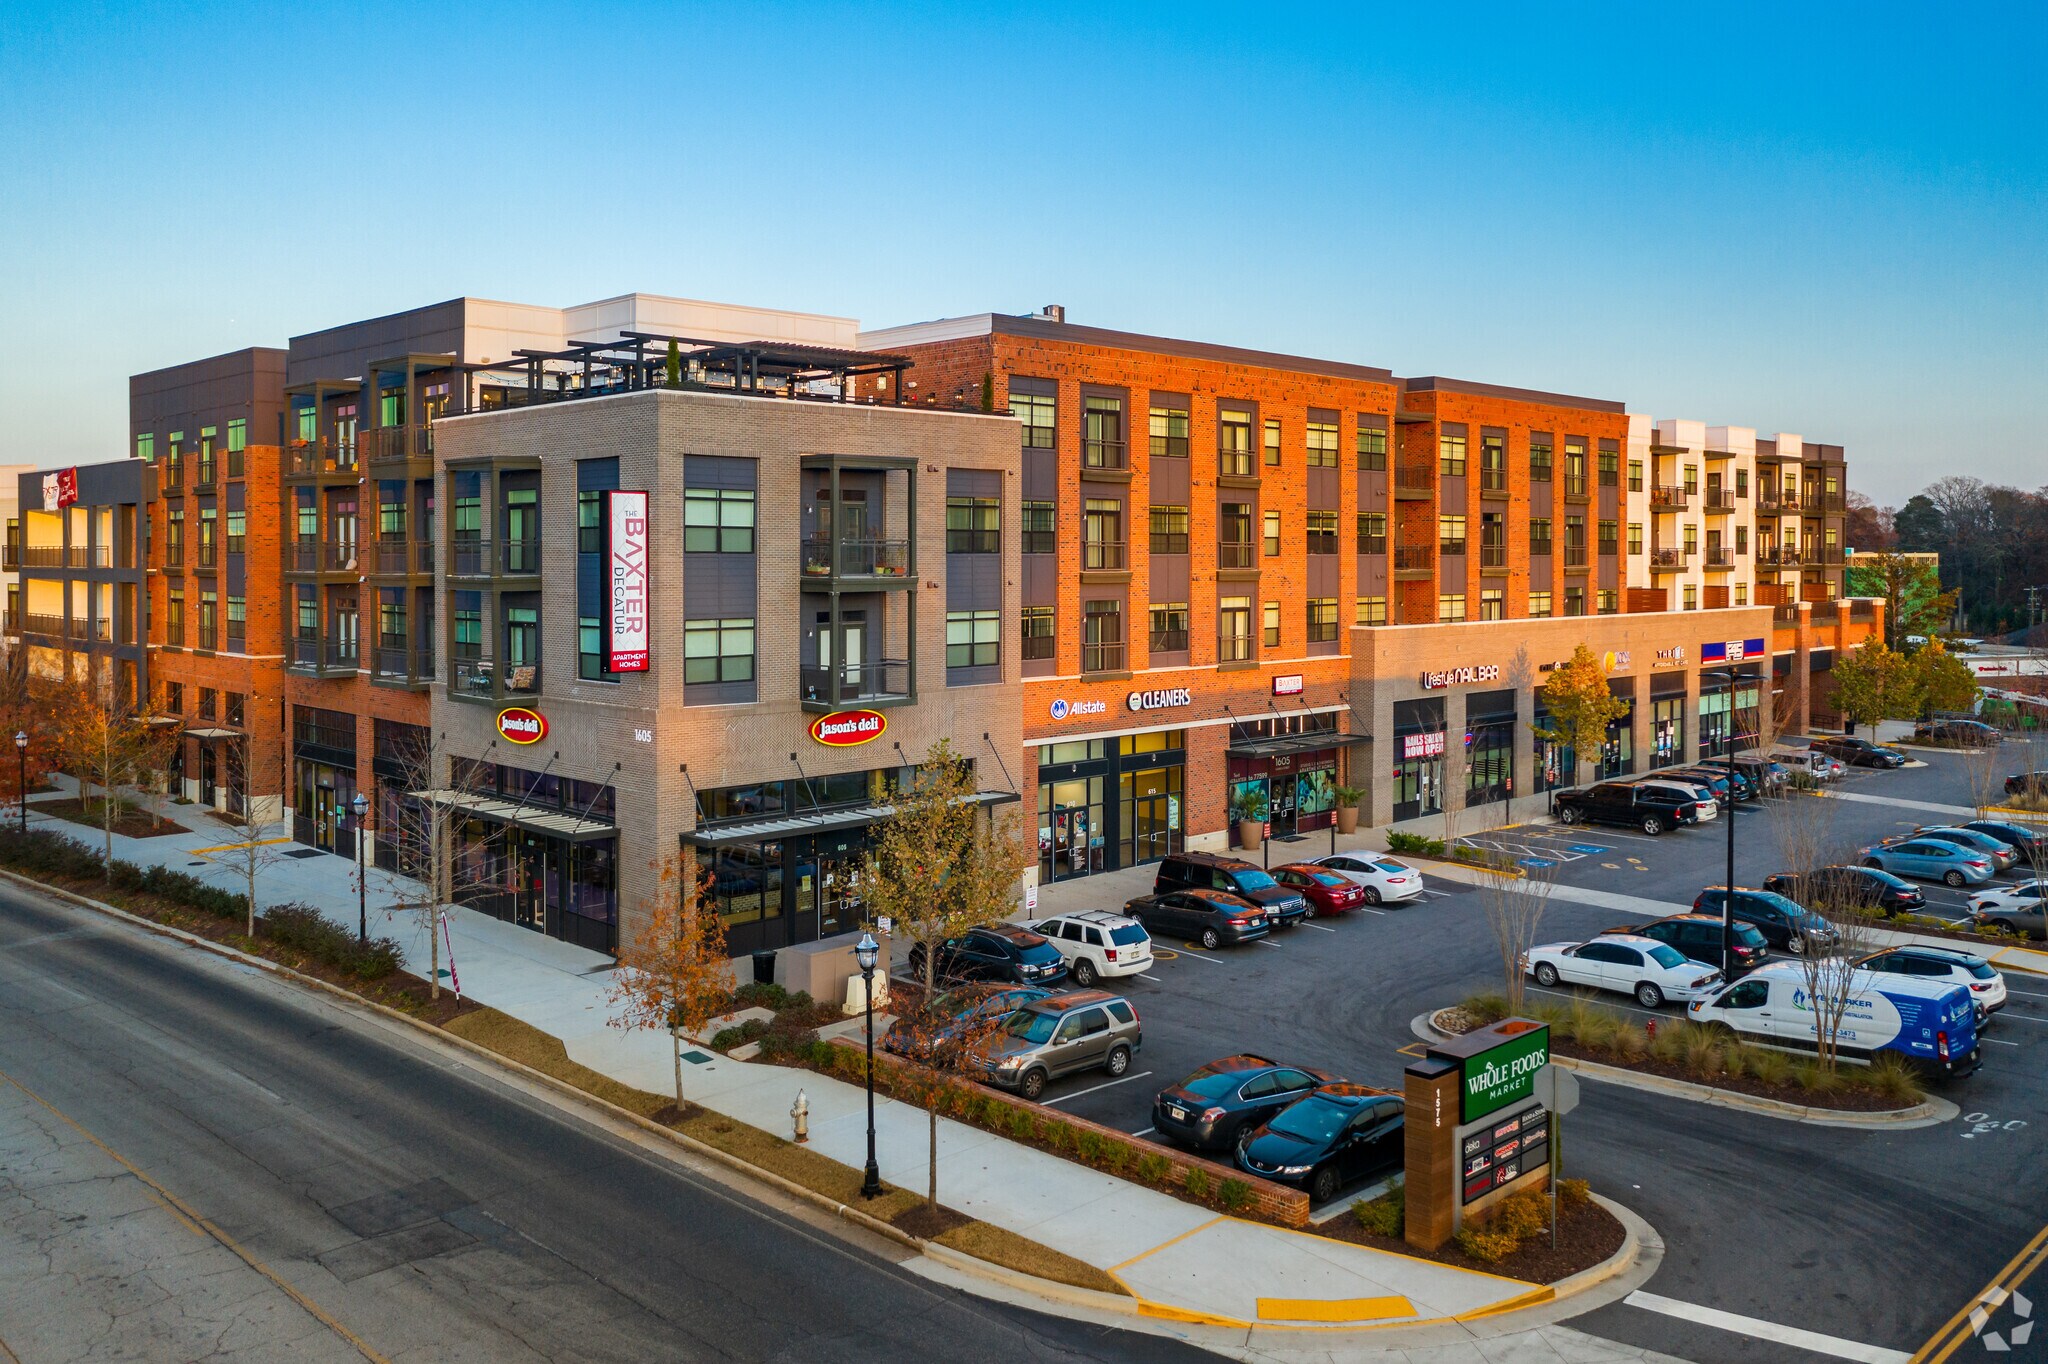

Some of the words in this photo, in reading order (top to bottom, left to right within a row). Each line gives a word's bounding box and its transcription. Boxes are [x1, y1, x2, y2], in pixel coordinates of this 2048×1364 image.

[613, 518, 645, 633] BAXTER
[614, 567, 624, 635] DECATUR
[612, 653, 647, 661] APARTMENT
[1142, 688, 1191, 709] CLEANERS
[1069, 700, 1106, 715] Allstate
[524, 719, 538, 733] deli
[819, 720, 857, 739] Jason's
[858, 716, 879, 732] deli
[634, 728, 652, 743] 1605
[1405, 735, 1424, 748] NAILS
[1405, 746, 1424, 758] NOW
[1275, 757, 1291, 767] 1605
[1468, 1061, 1509, 1095] WHOLE
[1511, 1048, 1546, 1078] FOODS
[1489, 1077, 1526, 1100] MARKET
